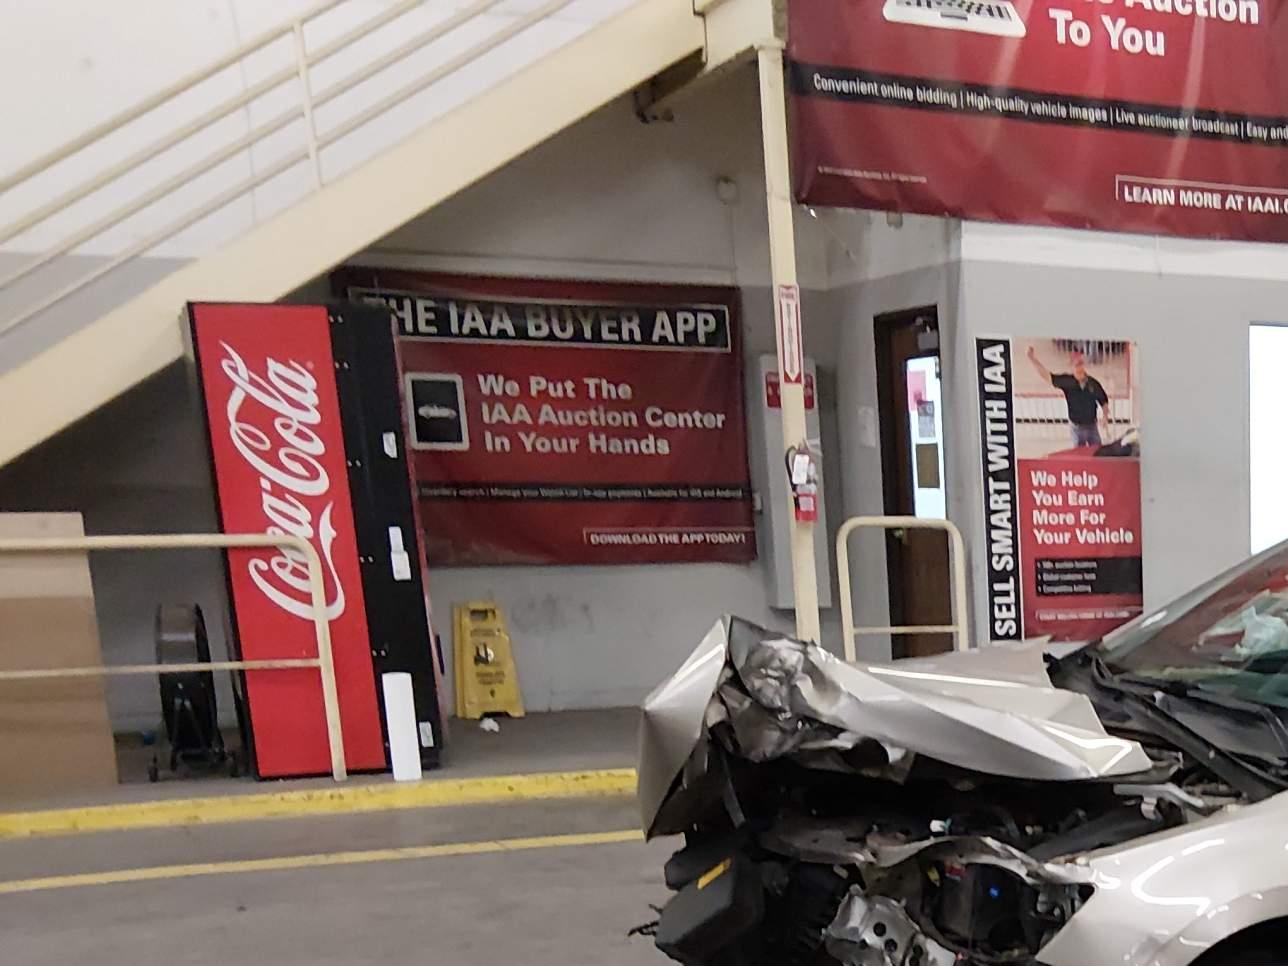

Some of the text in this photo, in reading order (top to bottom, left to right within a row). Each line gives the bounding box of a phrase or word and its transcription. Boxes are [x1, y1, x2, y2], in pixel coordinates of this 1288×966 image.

[1127, 0, 1260, 25] ction
[1049, 8, 1165, 57] To You
[813, 72, 878, 97] Convenient
[880, 84, 914, 102] online
[916, 86, 958, 109] bidding
[966, 91, 1029, 115] High-quality
[1030, 102, 1067, 119] vehicle
[1069, 103, 1108, 123] images
[1115, 109, 1136, 125] Live
[1137, 112, 1189, 131] auctioneer
[1246, 121, 1268, 142] Easy
[1124, 184, 1176, 207] LEARN
[1179, 189, 1222, 210] MORE
[1224, 192, 1245, 212] AT
[449, 301, 516, 337] IAA
[526, 305, 643, 344] BUYER
[651, 310, 718, 345] APP
[477, 374, 633, 400] We Put The
[481, 401, 727, 430] IAA Auction Center
[484, 431, 671, 456] In Your Hands
[982, 343, 1017, 637] SELL SMART WITH IAA
[1030, 470, 1098, 491] We Help
[1032, 489, 1104, 507] You Earn
[1032, 508, 1106, 526] More For
[590, 533, 658, 545] DOWNLOAD
[659, 533, 680, 544] THE
[681, 533, 704, 544] APP
[1033, 527, 1134, 545] Your Vehicle
